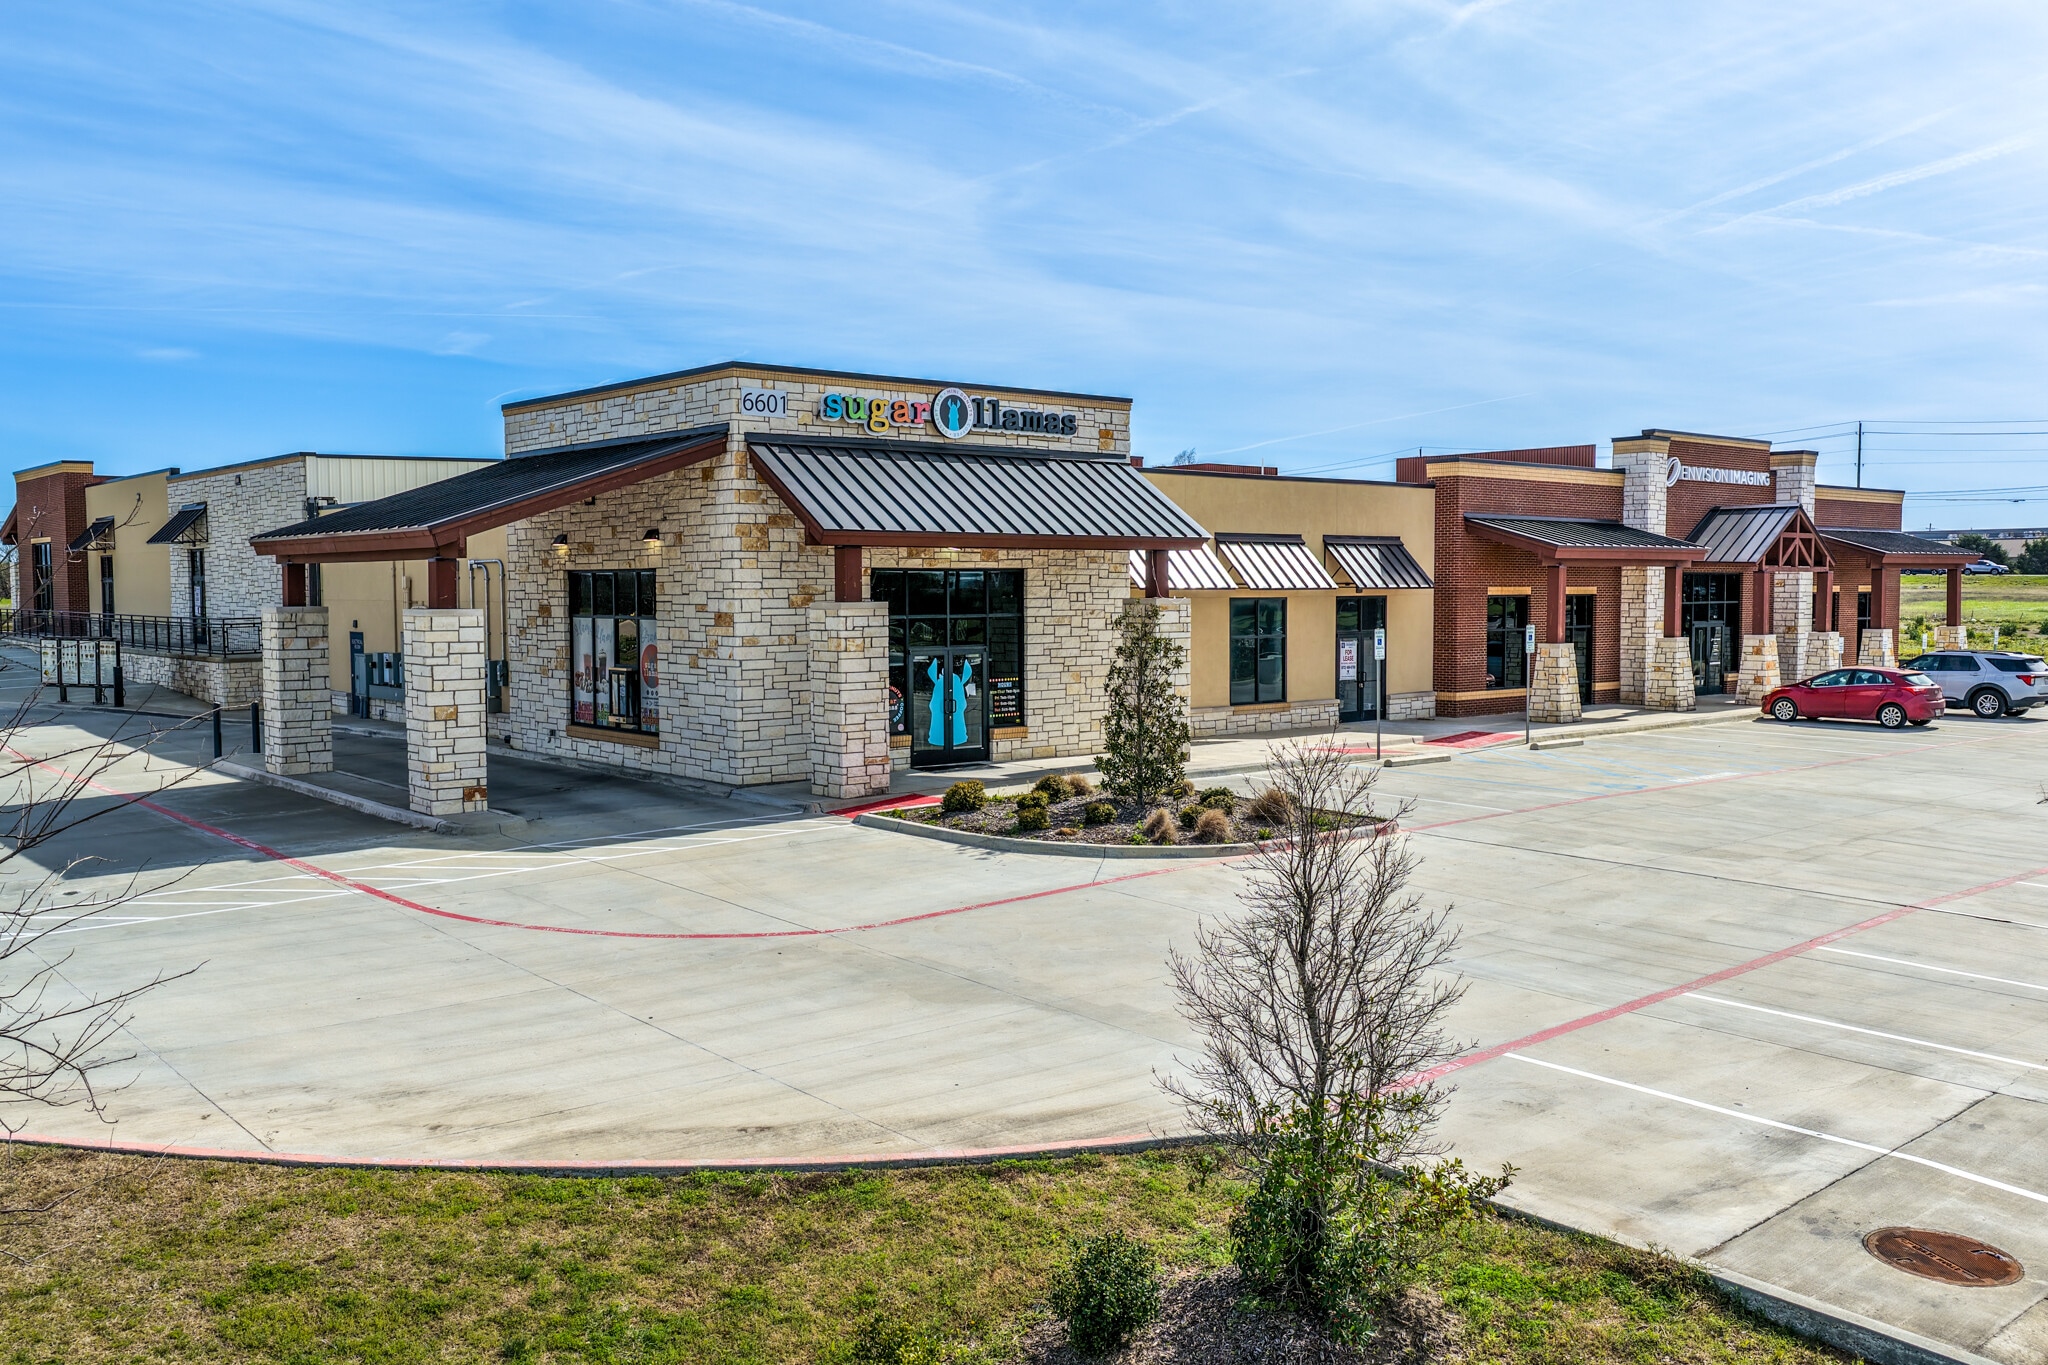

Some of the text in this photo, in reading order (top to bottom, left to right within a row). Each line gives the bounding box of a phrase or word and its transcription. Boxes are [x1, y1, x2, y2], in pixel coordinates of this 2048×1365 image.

[743, 392, 786, 415] 6601
[824, 393, 1077, 436] sugar llamas
[959, 392, 973, 417] DONUTS
[1682, 465, 1771, 487] ENVISION IMAGING
